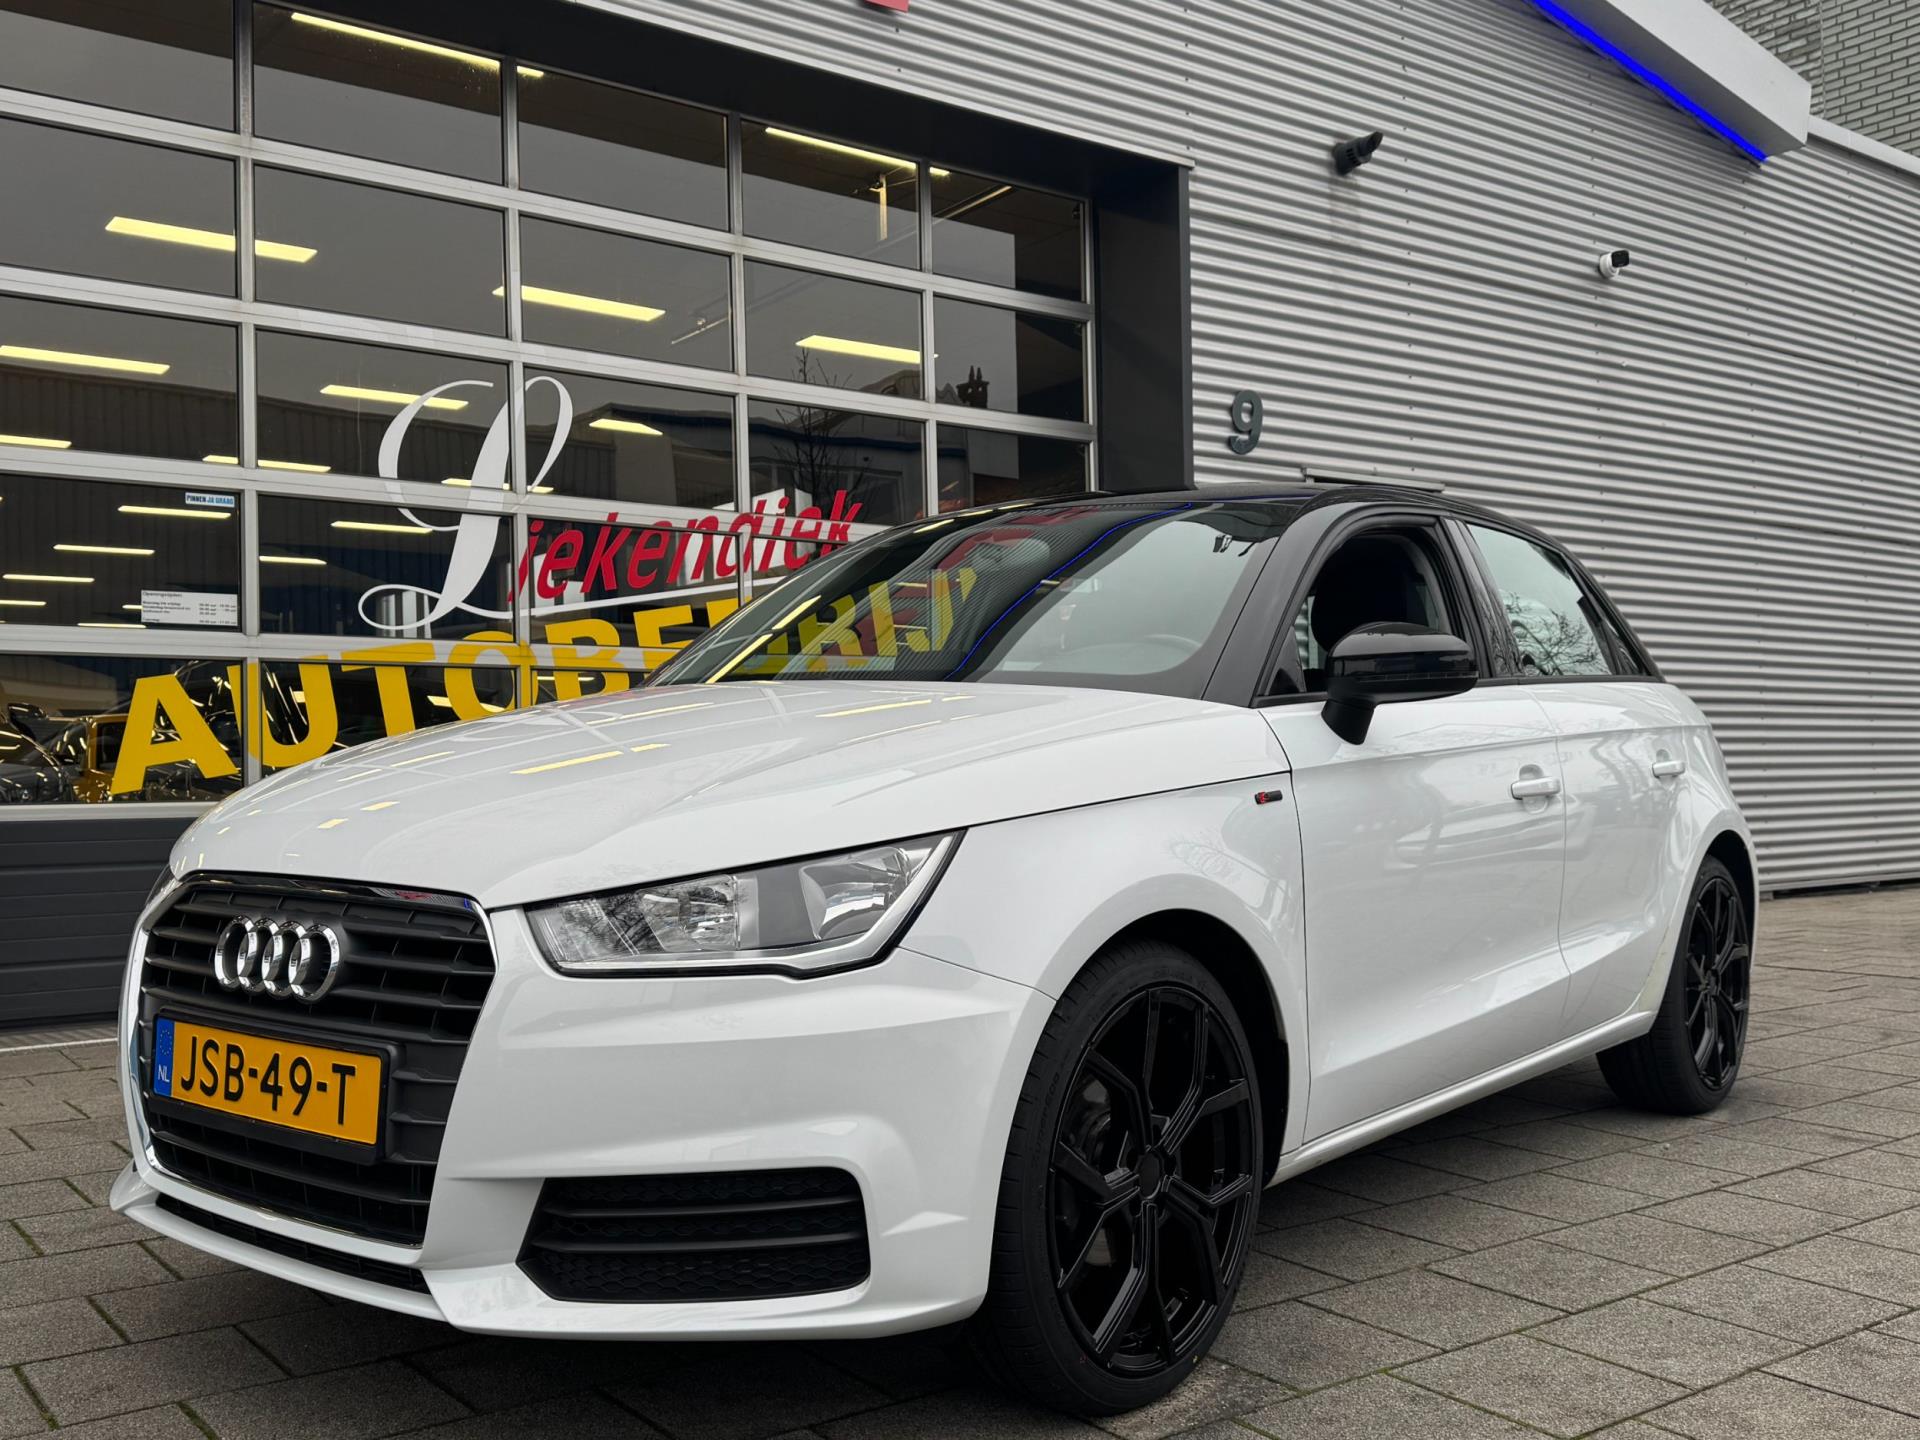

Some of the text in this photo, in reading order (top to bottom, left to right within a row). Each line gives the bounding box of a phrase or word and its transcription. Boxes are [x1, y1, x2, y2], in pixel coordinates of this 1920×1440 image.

[1228, 389, 1263, 455] 9
[157, 1065, 171, 1083] NL
[180, 1036, 356, 1126] JSB-49-T
